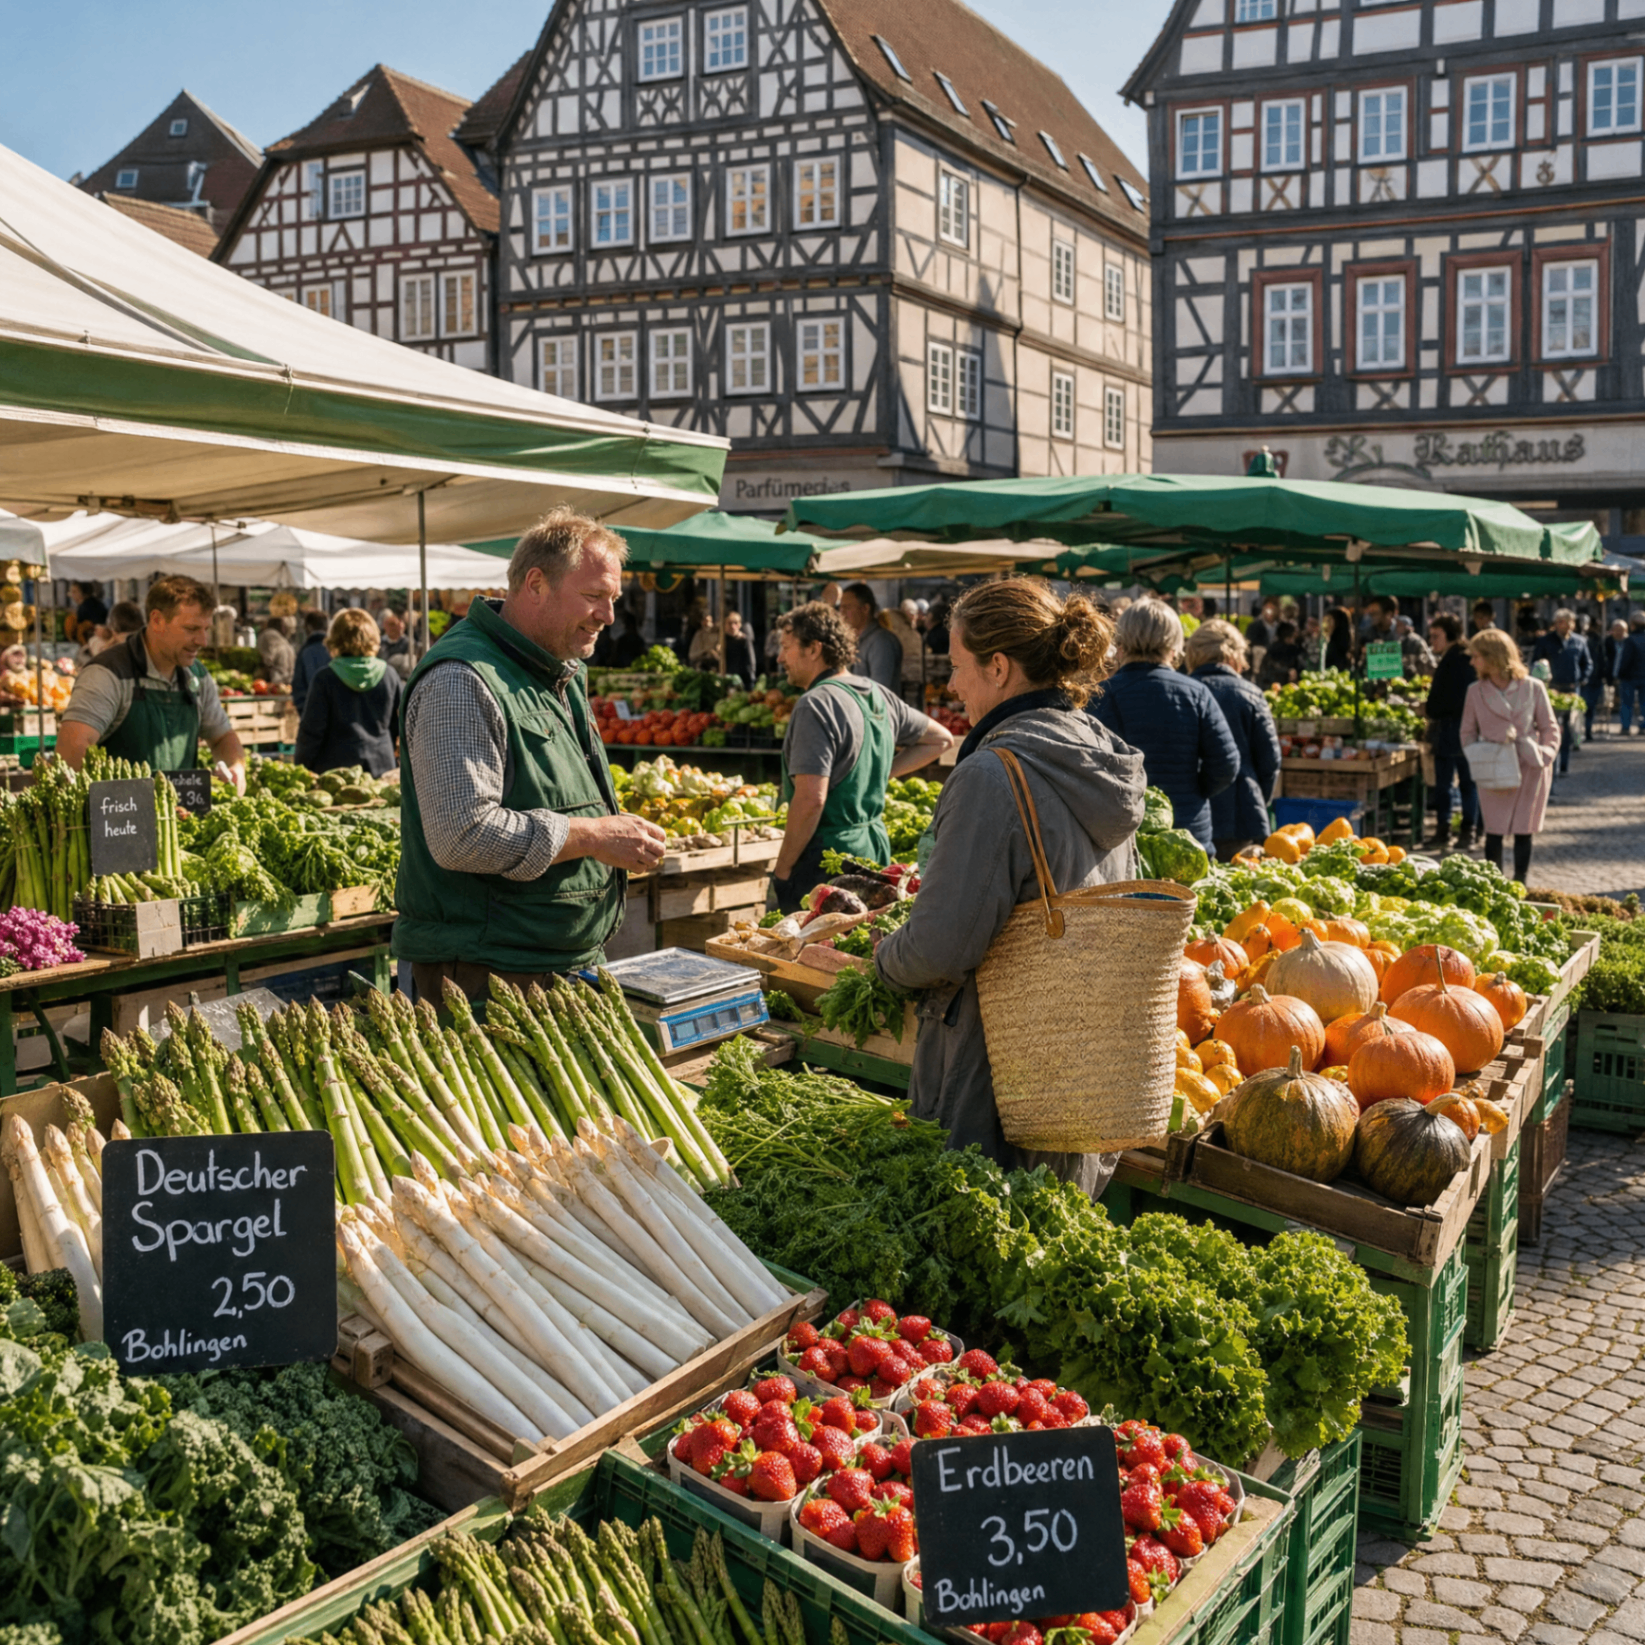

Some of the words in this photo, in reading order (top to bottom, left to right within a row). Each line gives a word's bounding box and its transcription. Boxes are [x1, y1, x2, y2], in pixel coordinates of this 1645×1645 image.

[100, 796, 138, 815] frisch
[104, 820, 138, 837] heute
[135, 1149, 308, 1196] Deutscher
[131, 1198, 287, 1262] Spargel
[211, 1271, 296, 1318] 2,50
[121, 1328, 247, 1363] Bohlingen
[937, 1445, 1094, 1492] Erdbeeren
[980, 1508, 1078, 1567] 3,50
[934, 1576, 1045, 1614] Bohlingen
